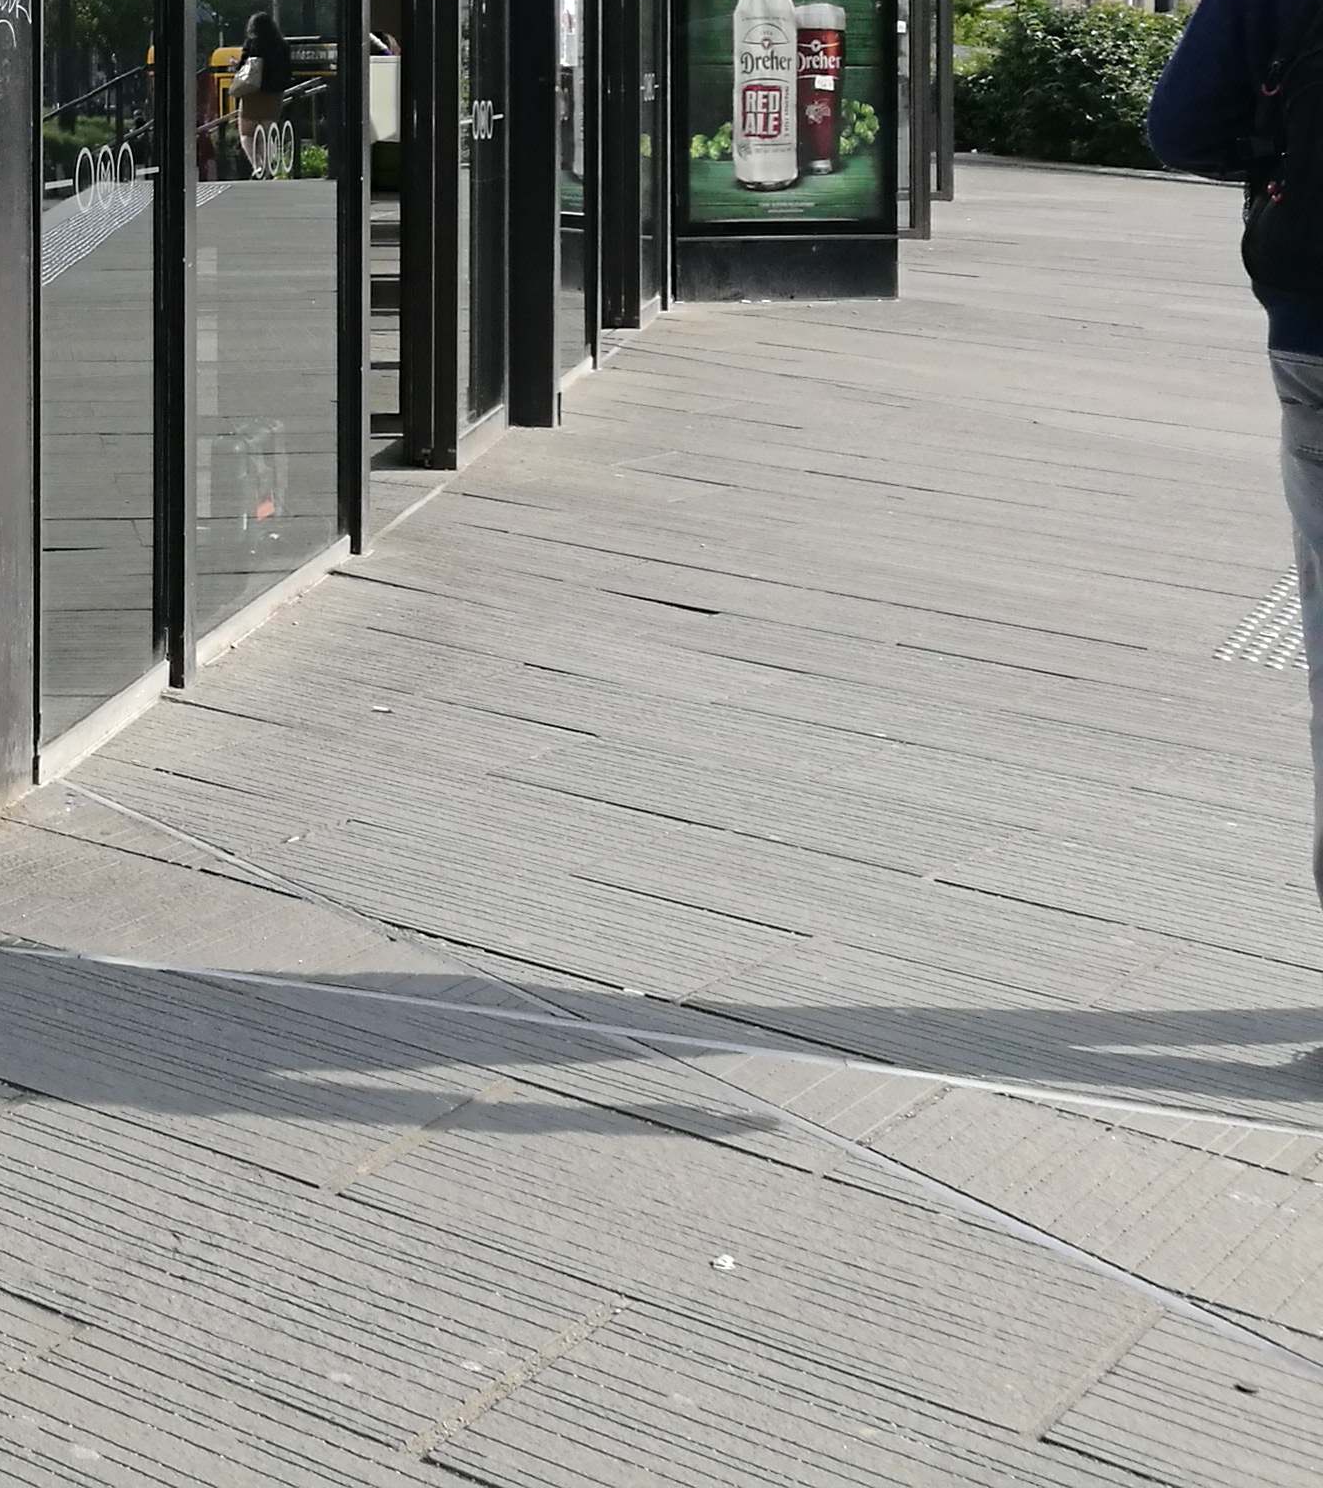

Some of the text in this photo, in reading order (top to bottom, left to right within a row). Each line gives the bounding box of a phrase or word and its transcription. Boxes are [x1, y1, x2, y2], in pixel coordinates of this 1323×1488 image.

[741, 50, 792, 74] Dreher
[746, 91, 779, 112] RED
[744, 113, 779, 135] ALE
